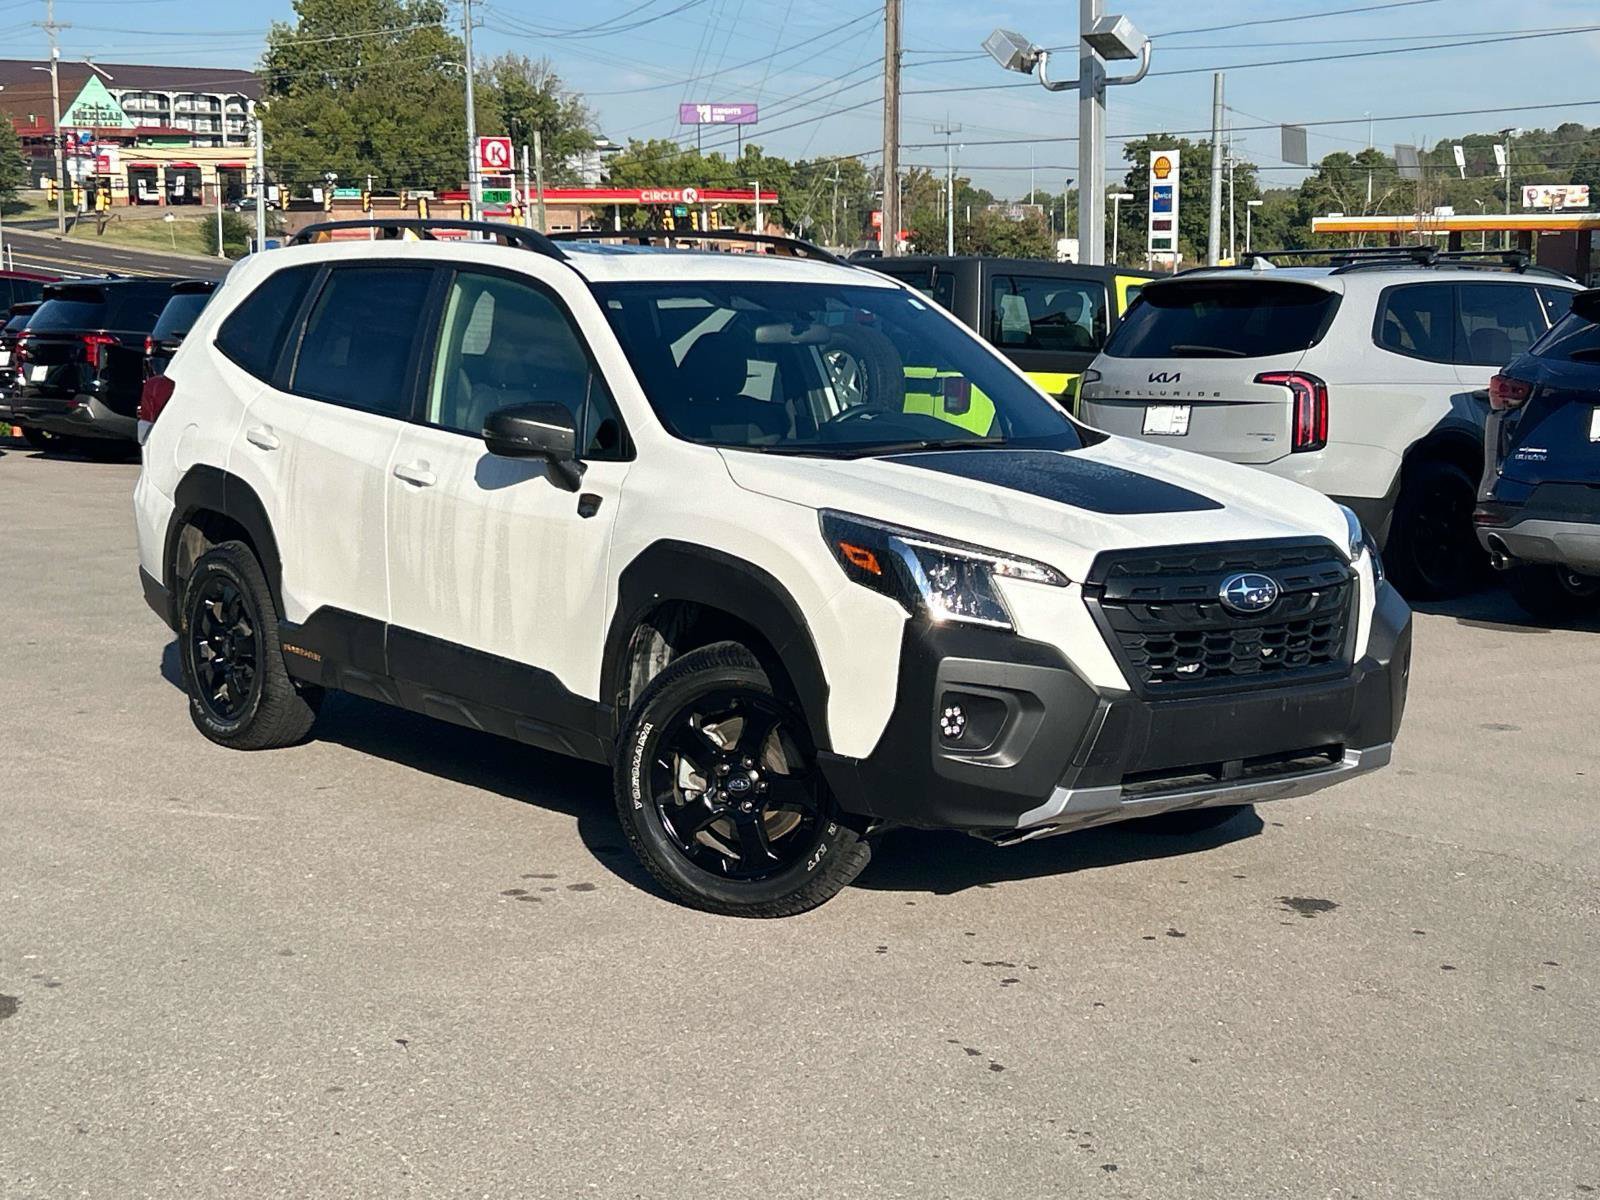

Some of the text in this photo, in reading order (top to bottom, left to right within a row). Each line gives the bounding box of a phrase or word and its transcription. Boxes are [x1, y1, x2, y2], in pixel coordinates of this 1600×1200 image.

[72, 110, 123, 121] MEXCAN
[641, 190, 680, 201] CIRCLE
[1149, 372, 1181, 383] KIA
[1114, 390, 1221, 398] TELLURIDE
[632, 722, 654, 810] YOKOHAMA
